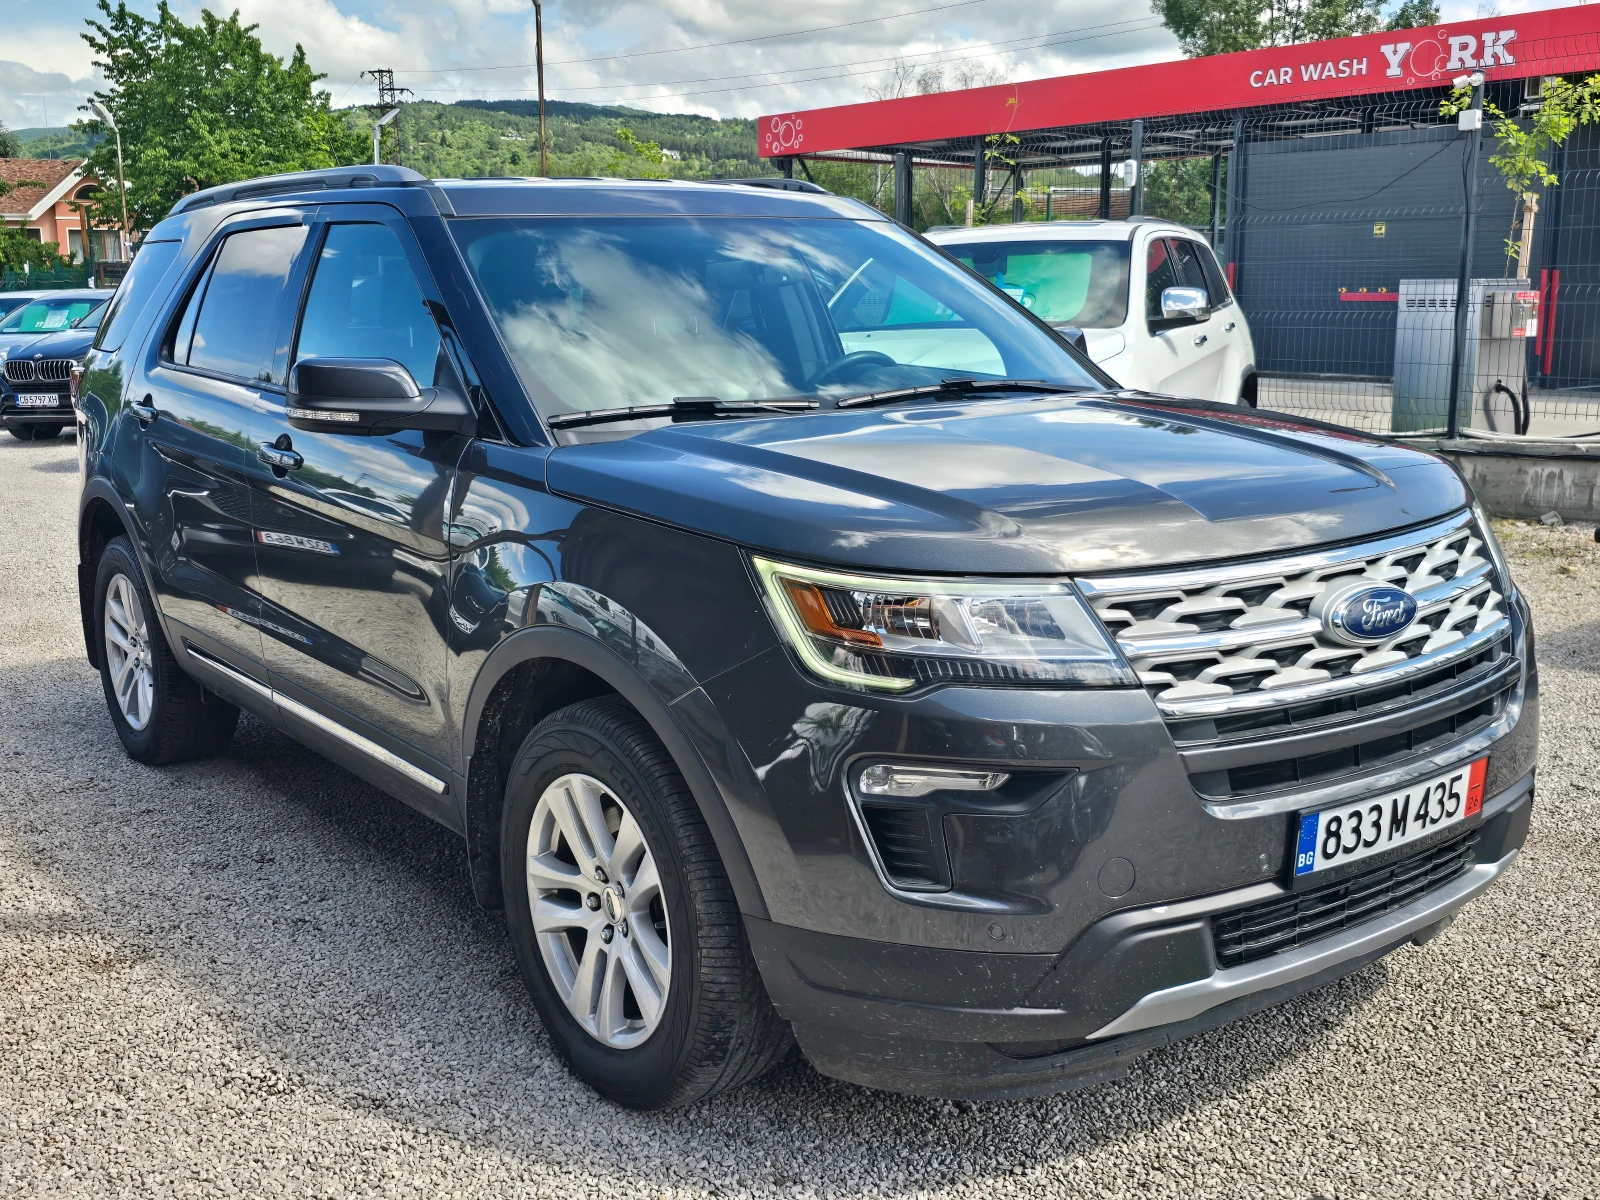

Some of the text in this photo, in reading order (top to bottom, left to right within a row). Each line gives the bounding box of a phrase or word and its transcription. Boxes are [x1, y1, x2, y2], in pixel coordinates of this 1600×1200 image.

[1249, 29, 1516, 88] CAR WASH YORK
[29, 395, 46, 404] 5797
[1361, 596, 1406, 631] Ford
[1468, 795, 1479, 810] 26
[1322, 804, 1383, 860] 833
[1387, 793, 1411, 842] M
[1413, 773, 1463, 829] 435
[1298, 851, 1314, 868] BG
